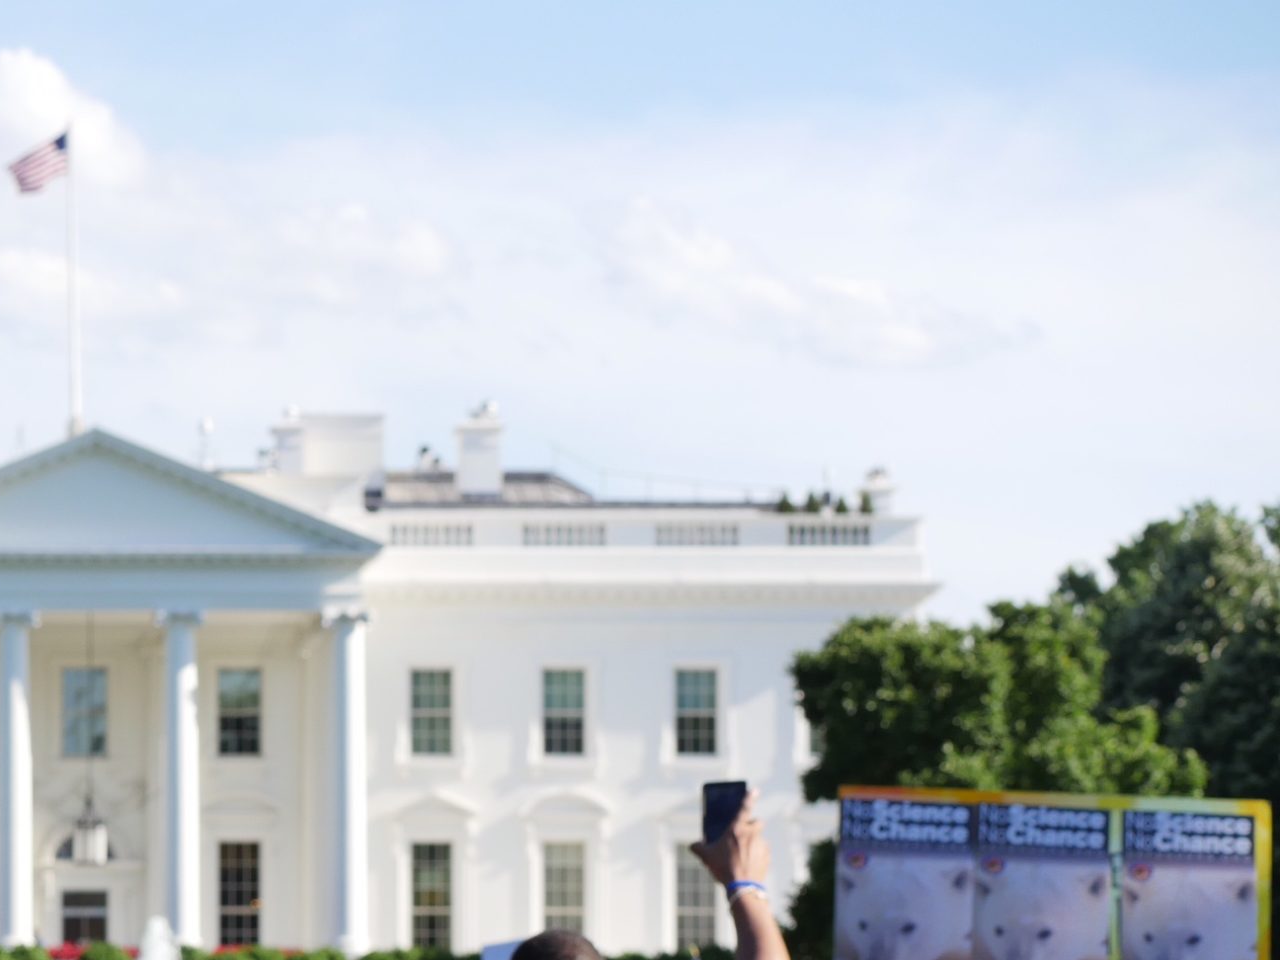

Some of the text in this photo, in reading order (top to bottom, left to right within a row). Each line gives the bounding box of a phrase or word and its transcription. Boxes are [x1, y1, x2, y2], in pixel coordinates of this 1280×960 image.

[872, 799, 969, 823] Science
[1007, 804, 1105, 829] Science
[870, 820, 969, 843] Chance
[1154, 811, 1251, 836] Science
[1006, 826, 1104, 849] Chance
[1153, 833, 1251, 856] Chance
